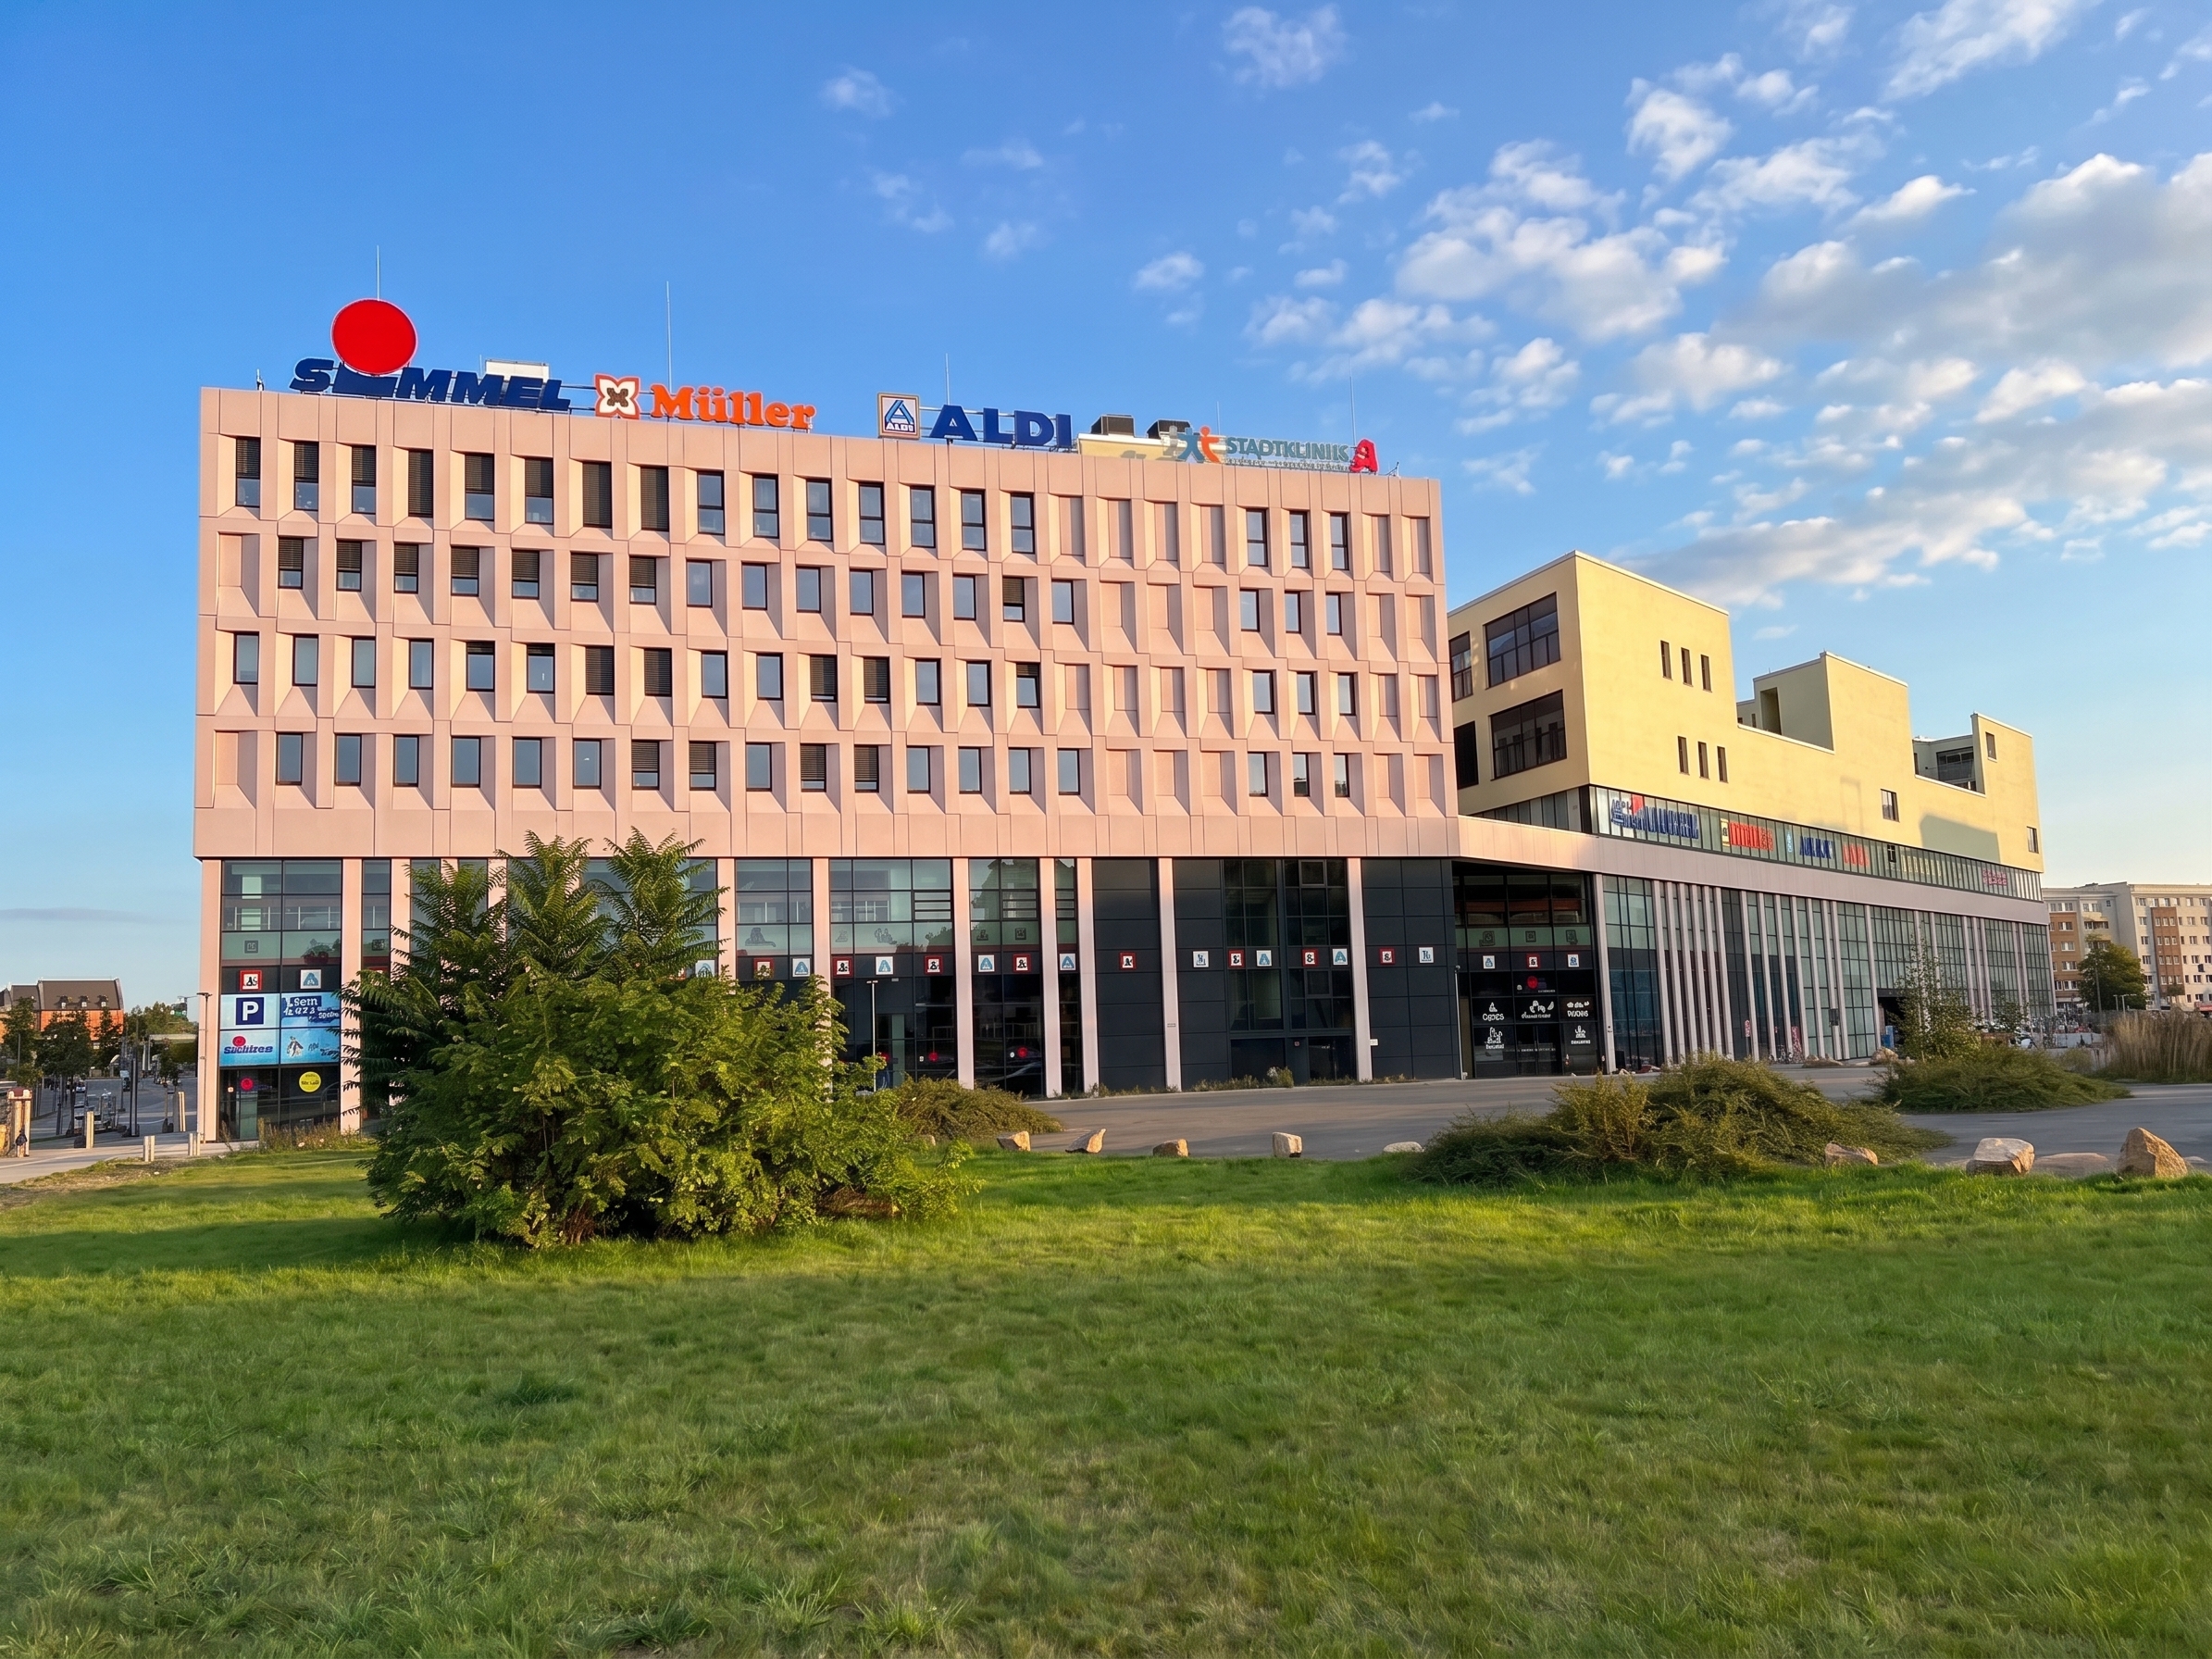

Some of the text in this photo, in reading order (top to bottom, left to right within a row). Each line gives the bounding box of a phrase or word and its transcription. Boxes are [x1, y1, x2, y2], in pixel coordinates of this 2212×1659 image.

[651, 384, 816, 430] Müller
[929, 405, 1072, 447] ALDI
[242, 1001, 259, 1021] P
